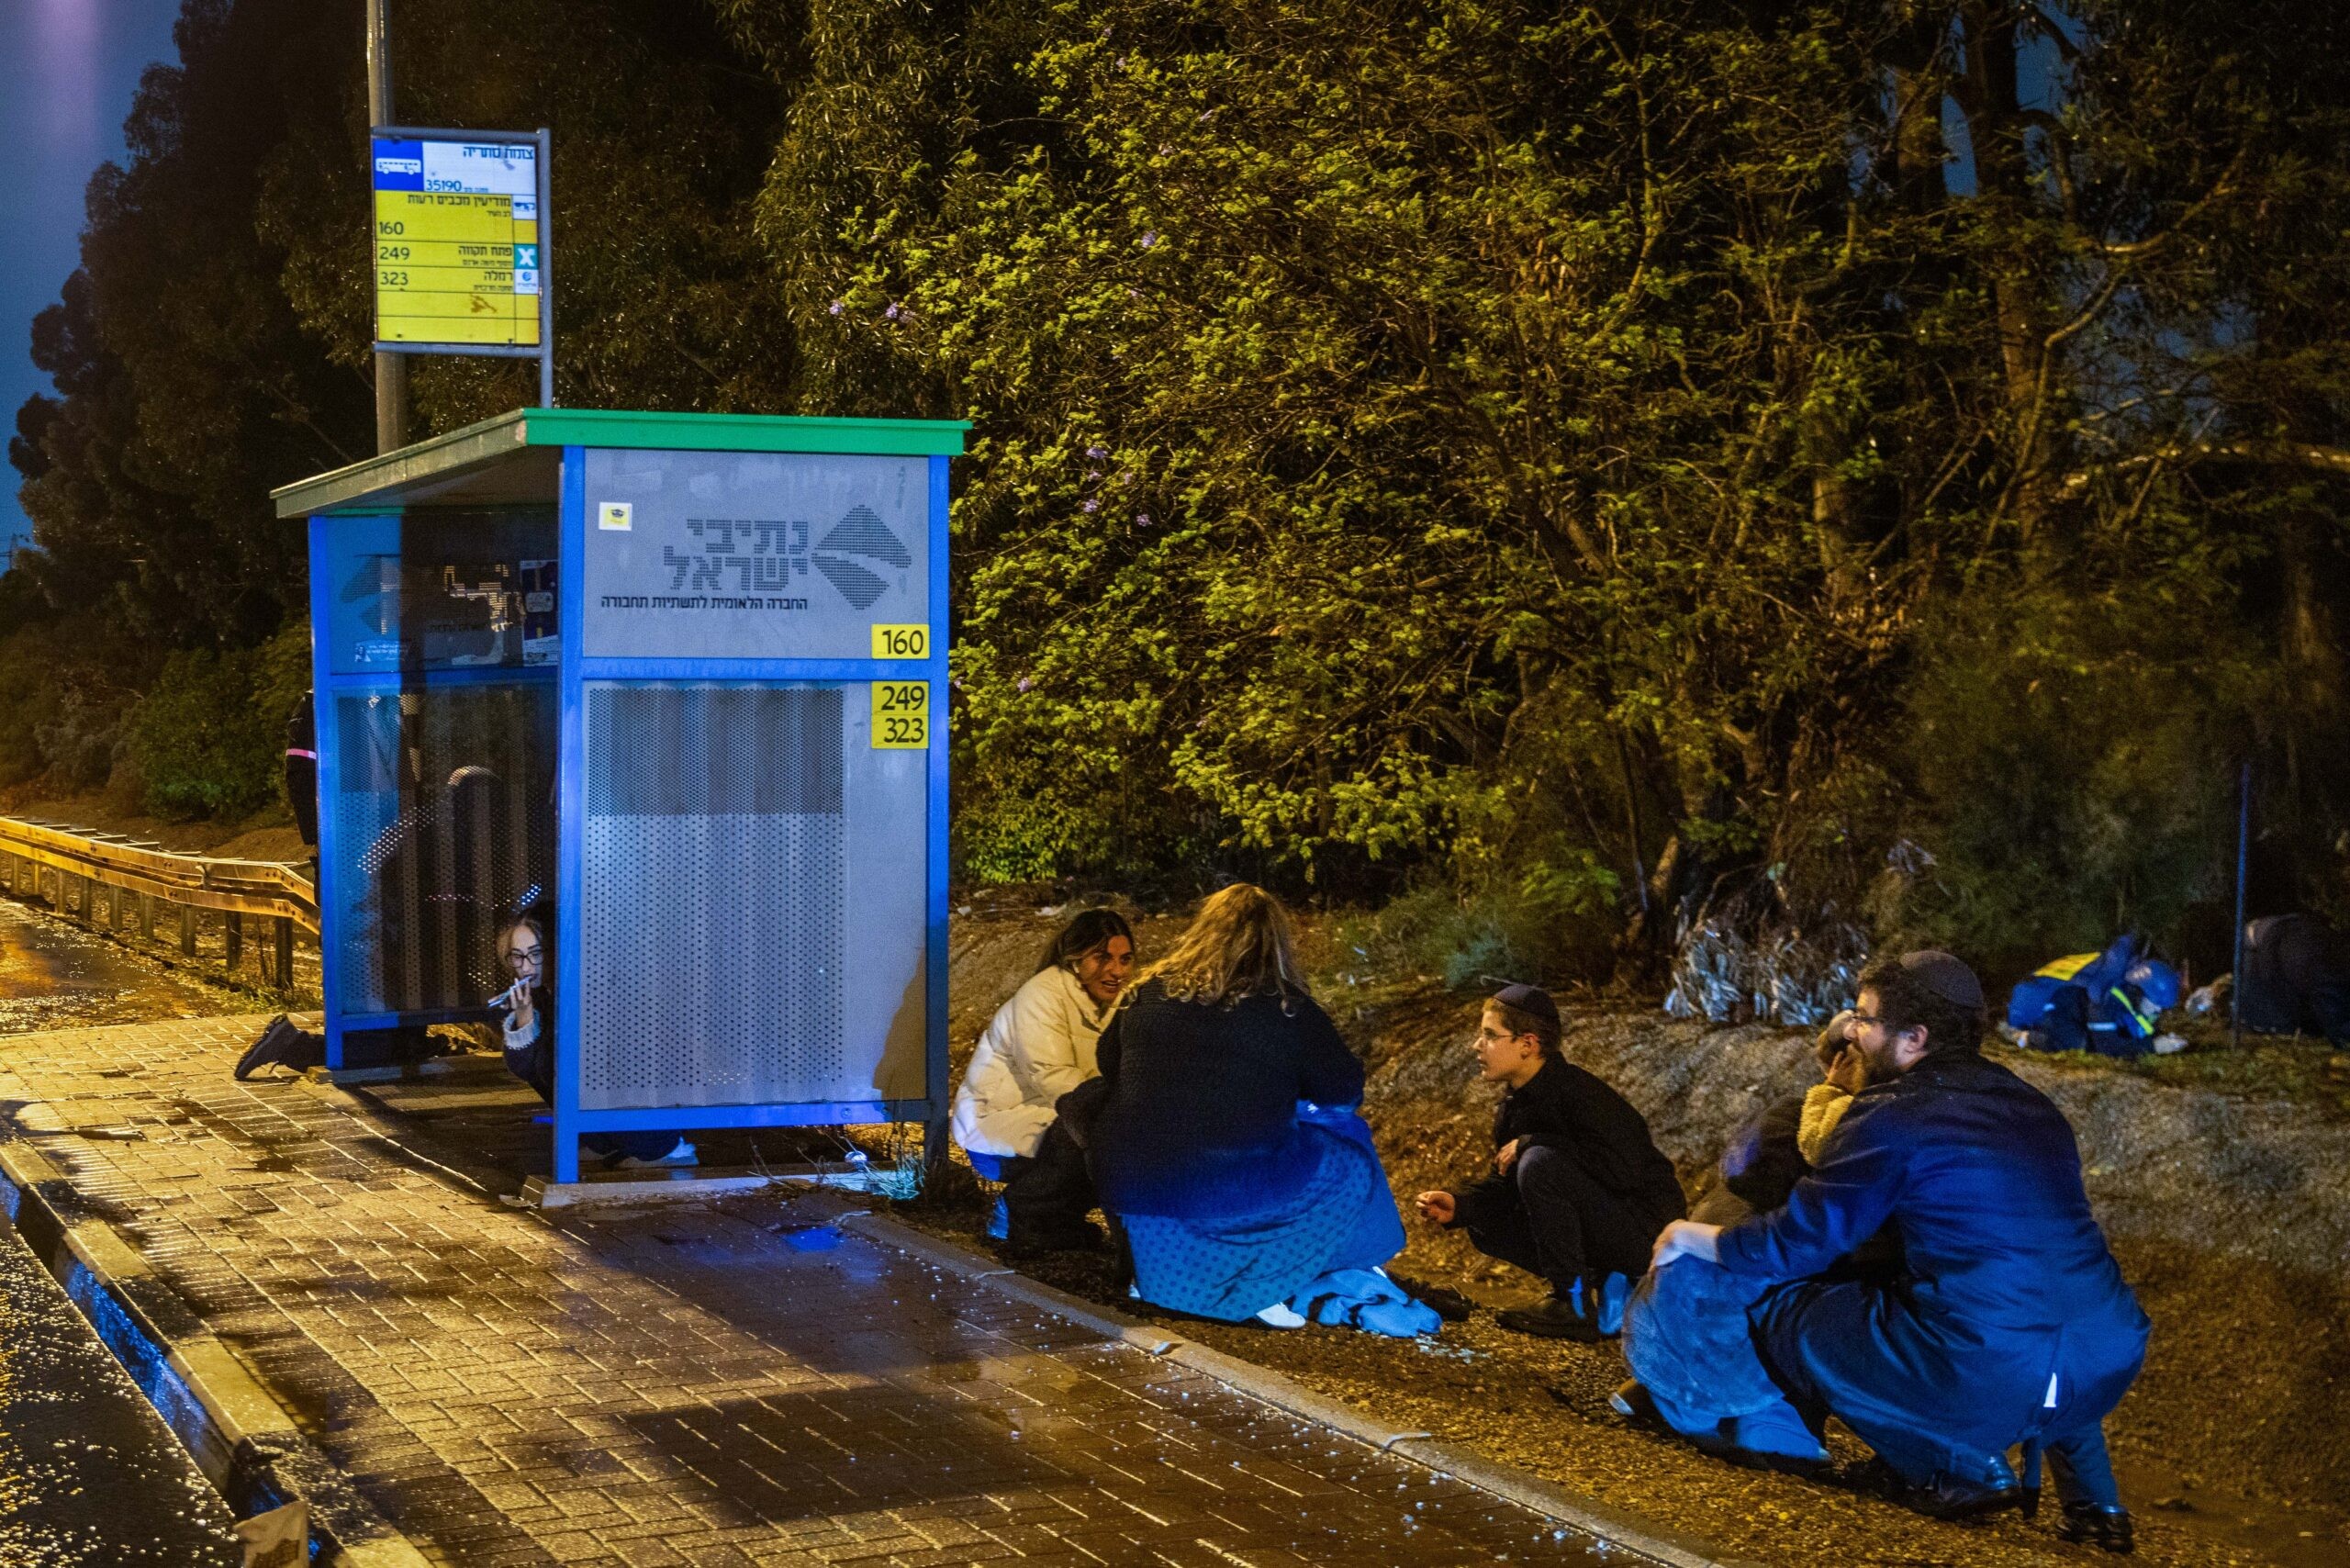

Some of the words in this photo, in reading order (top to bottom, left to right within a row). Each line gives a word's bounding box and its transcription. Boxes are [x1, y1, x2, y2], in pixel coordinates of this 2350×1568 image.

[463, 146, 501, 158] סתריה
[504, 147, 534, 160] צומת
[426, 179, 462, 192] 35190
[408, 194, 433, 204] רעות
[437, 195, 470, 206] מכבים
[474, 196, 511, 207] מודיעין
[379, 221, 404, 235] 160
[379, 246, 410, 261] 249
[458, 245, 487, 256] תקווה
[490, 246, 512, 256] פתח
[380, 272, 408, 286] 323
[484, 271, 513, 281] רמלה
[687, 519, 809, 554] נתיבי
[664, 545, 809, 591] ישראל
[601, 596, 648, 608] תחבורה
[651, 595, 707, 609] לתשתיות
[710, 596, 764, 610] הלאומית
[767, 598, 808, 610] החברה
[882, 630, 923, 655] 160
[881, 686, 925, 711] 249
[884, 717, 924, 743] 323
